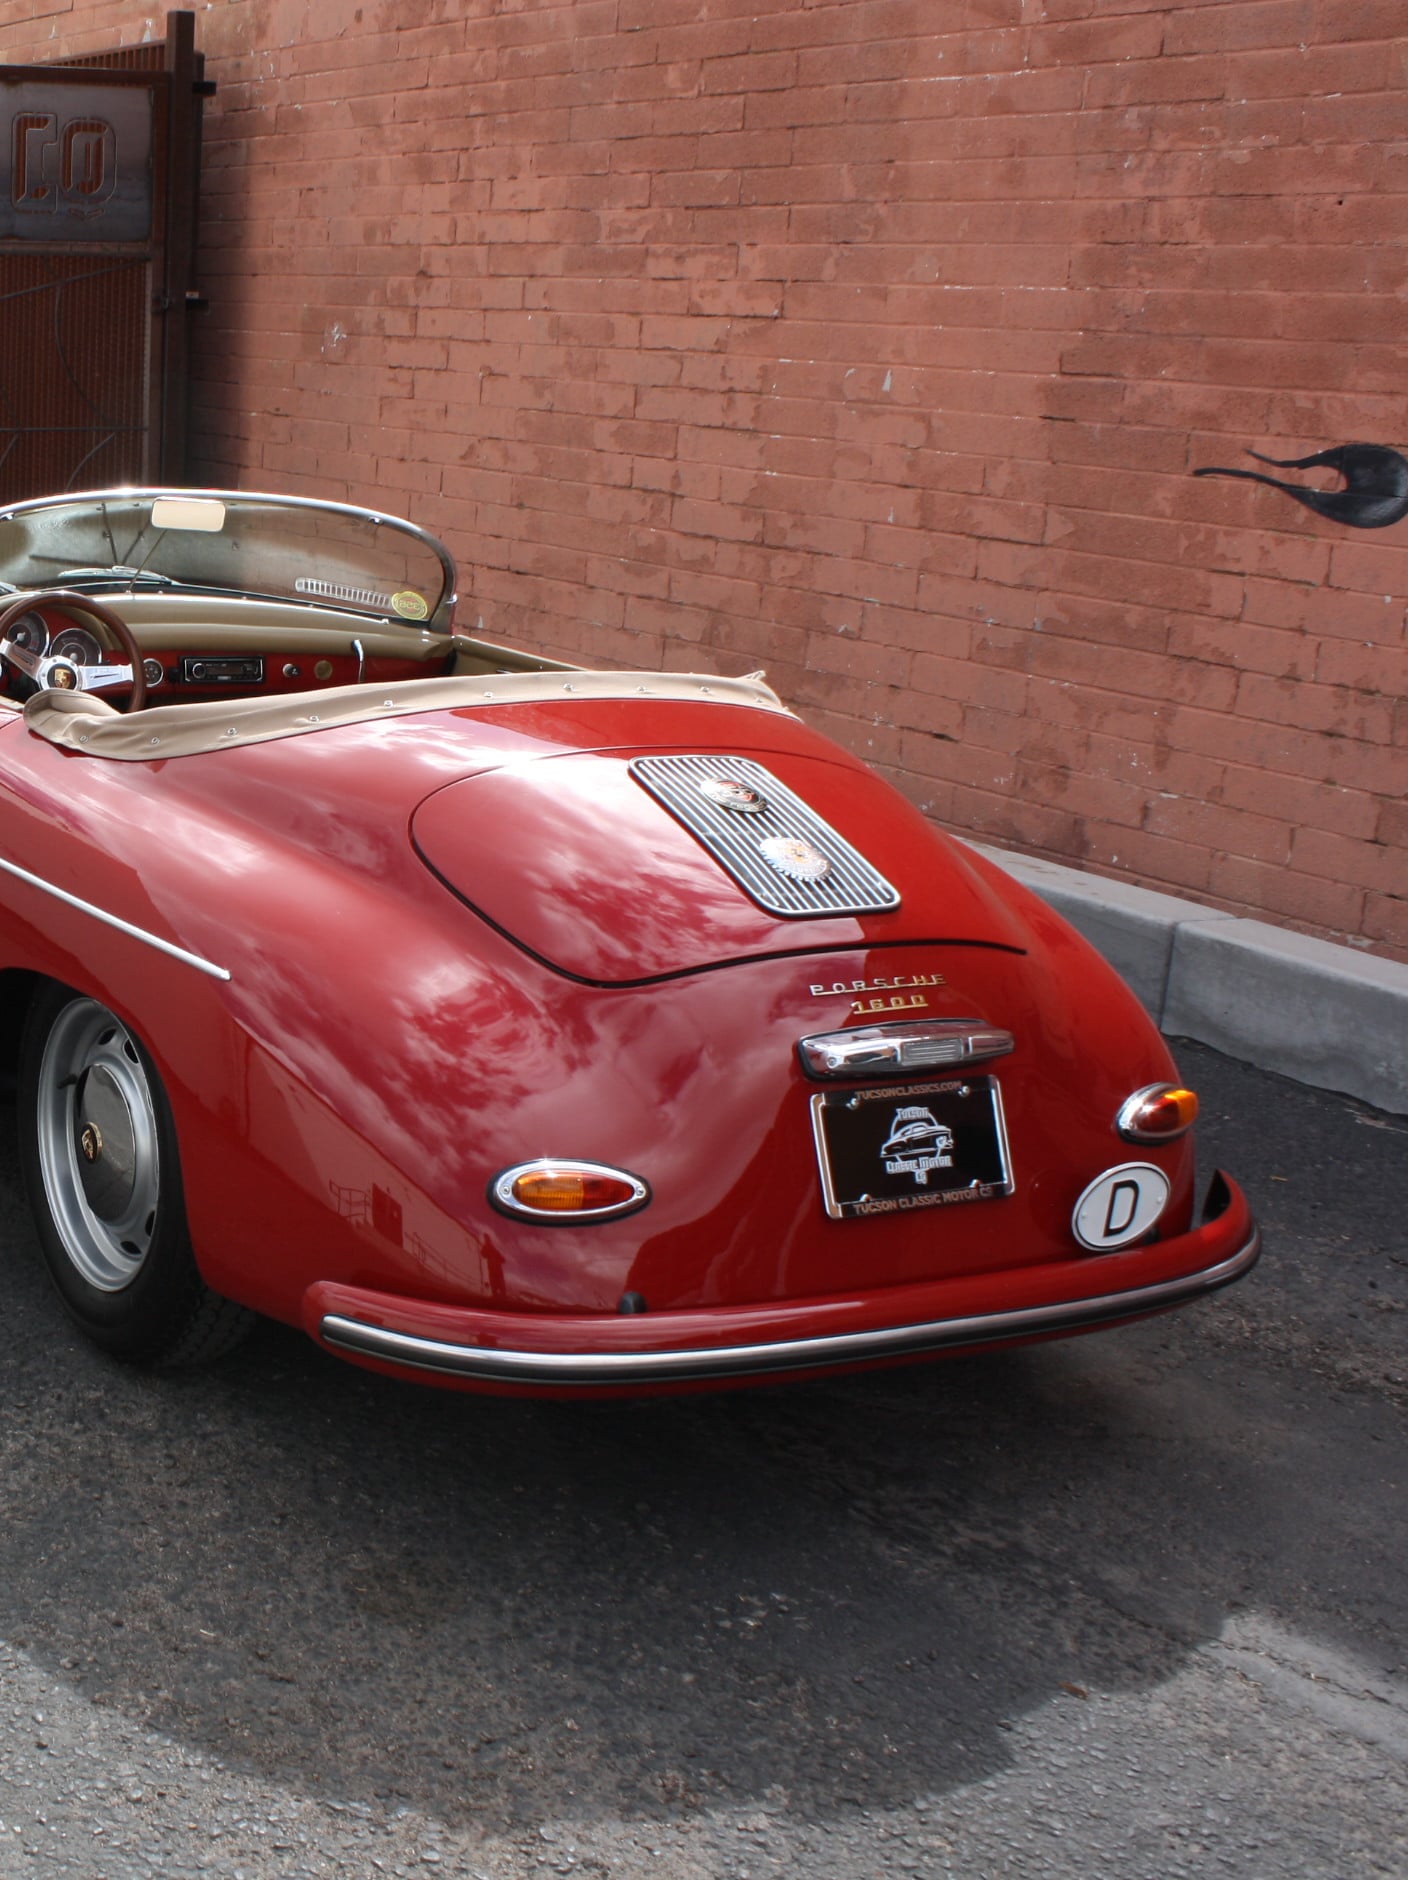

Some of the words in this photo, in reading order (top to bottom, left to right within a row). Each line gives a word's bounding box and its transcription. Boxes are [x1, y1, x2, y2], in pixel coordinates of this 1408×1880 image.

[11, 112, 117, 218] CO
[809, 974, 946, 996] PORSCHE
[850, 994, 928, 1014] 1600
[855, 1080, 963, 1101] TUCSONCLASSICS.COM
[853, 1199, 897, 1215] TUCSON
[898, 1193, 943, 1209] CLASSIC
[942, 1188, 979, 1205] MOTOR
[1103, 1179, 1140, 1238] D
